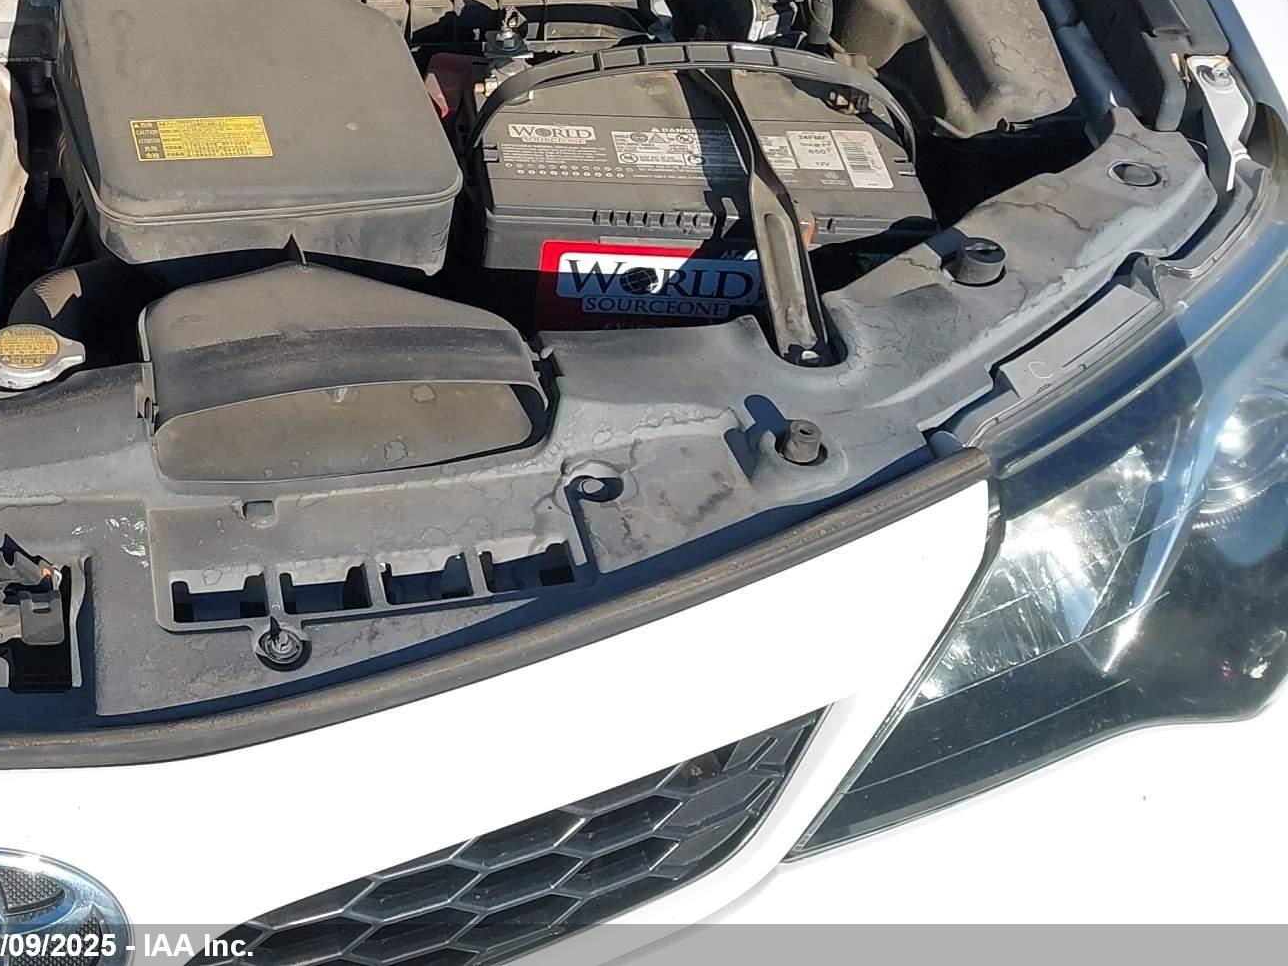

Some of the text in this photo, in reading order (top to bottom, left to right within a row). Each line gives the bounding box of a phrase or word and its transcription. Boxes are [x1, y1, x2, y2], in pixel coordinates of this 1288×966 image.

[511, 125, 593, 138] WORLD
[567, 258, 754, 301] WORLD
[584, 297, 728, 317] SOURCEONE
